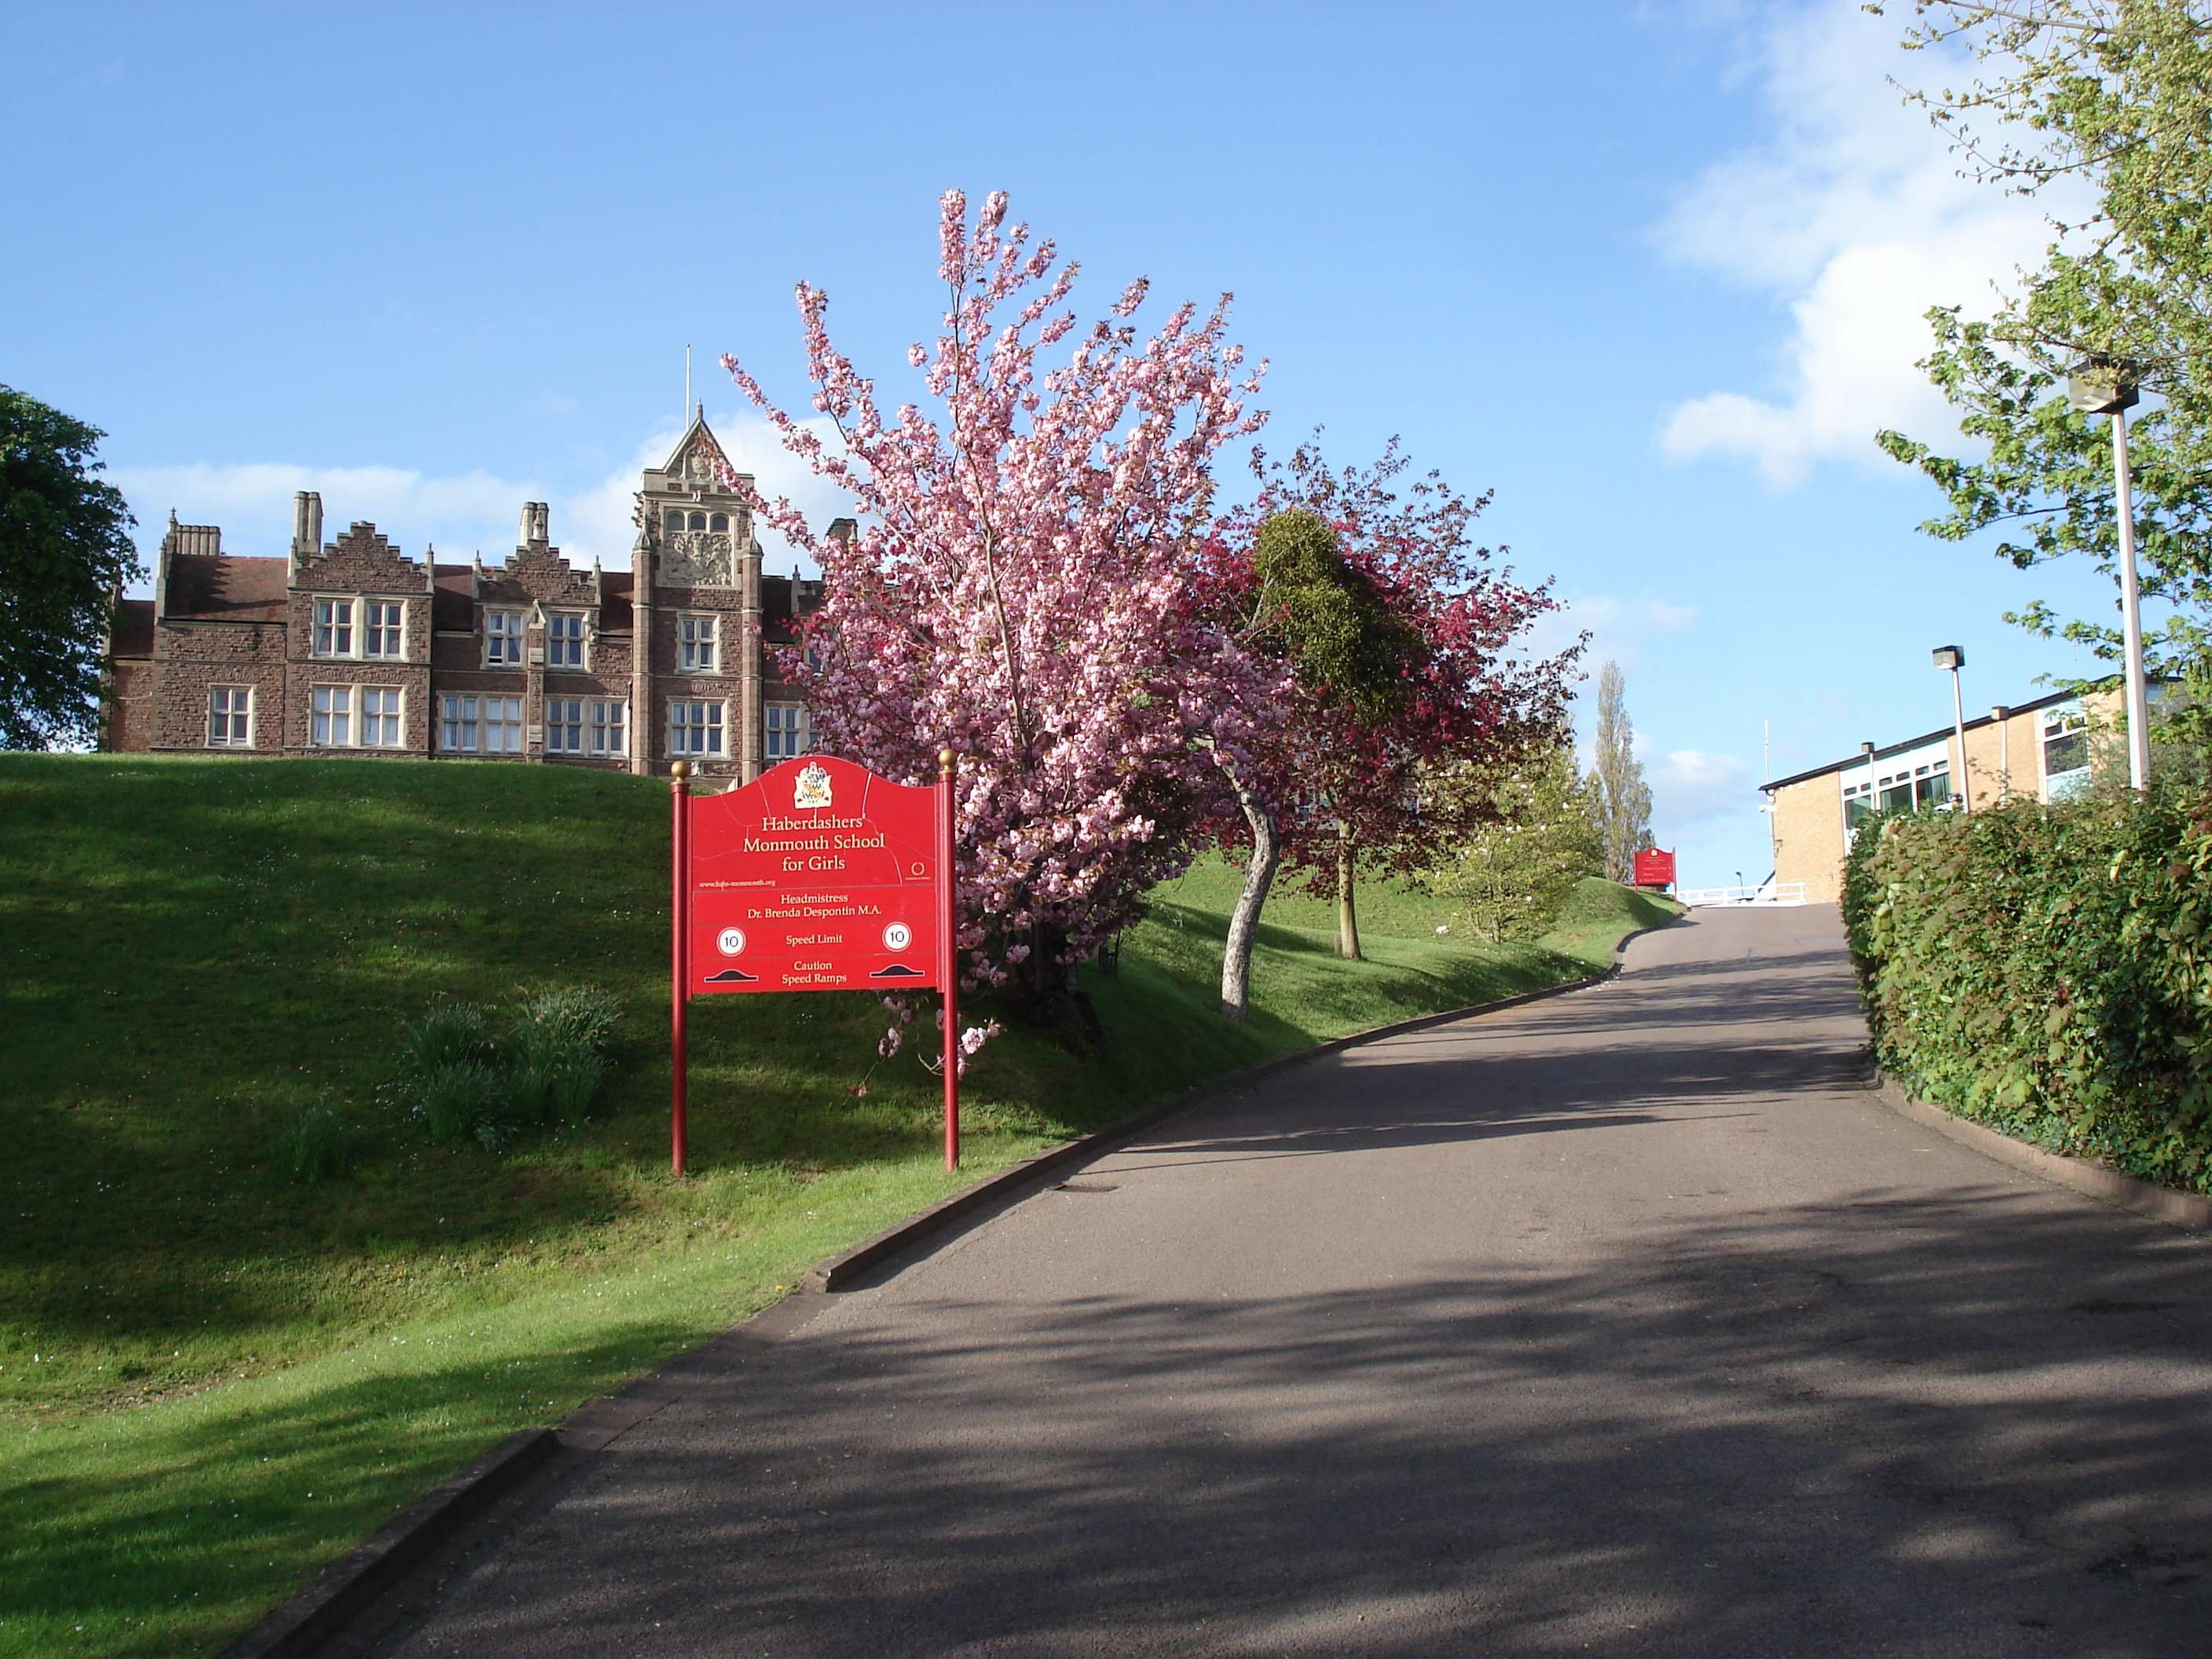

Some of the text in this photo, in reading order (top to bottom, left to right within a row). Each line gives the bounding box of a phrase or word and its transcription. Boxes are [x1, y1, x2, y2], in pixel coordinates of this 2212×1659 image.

[743, 833, 885, 851] Monmouth School
[782, 855, 846, 872] for Girls
[781, 894, 848, 904] Headmistress
[747, 905, 882, 919] Dr. Brenda Despontin M.A.
[724, 936, 739, 948] 10
[786, 935, 843, 947] Speed Limit
[889, 931, 905, 943] 10
[793, 961, 833, 971] Caution
[782, 974, 848, 986] Speed Ramps
